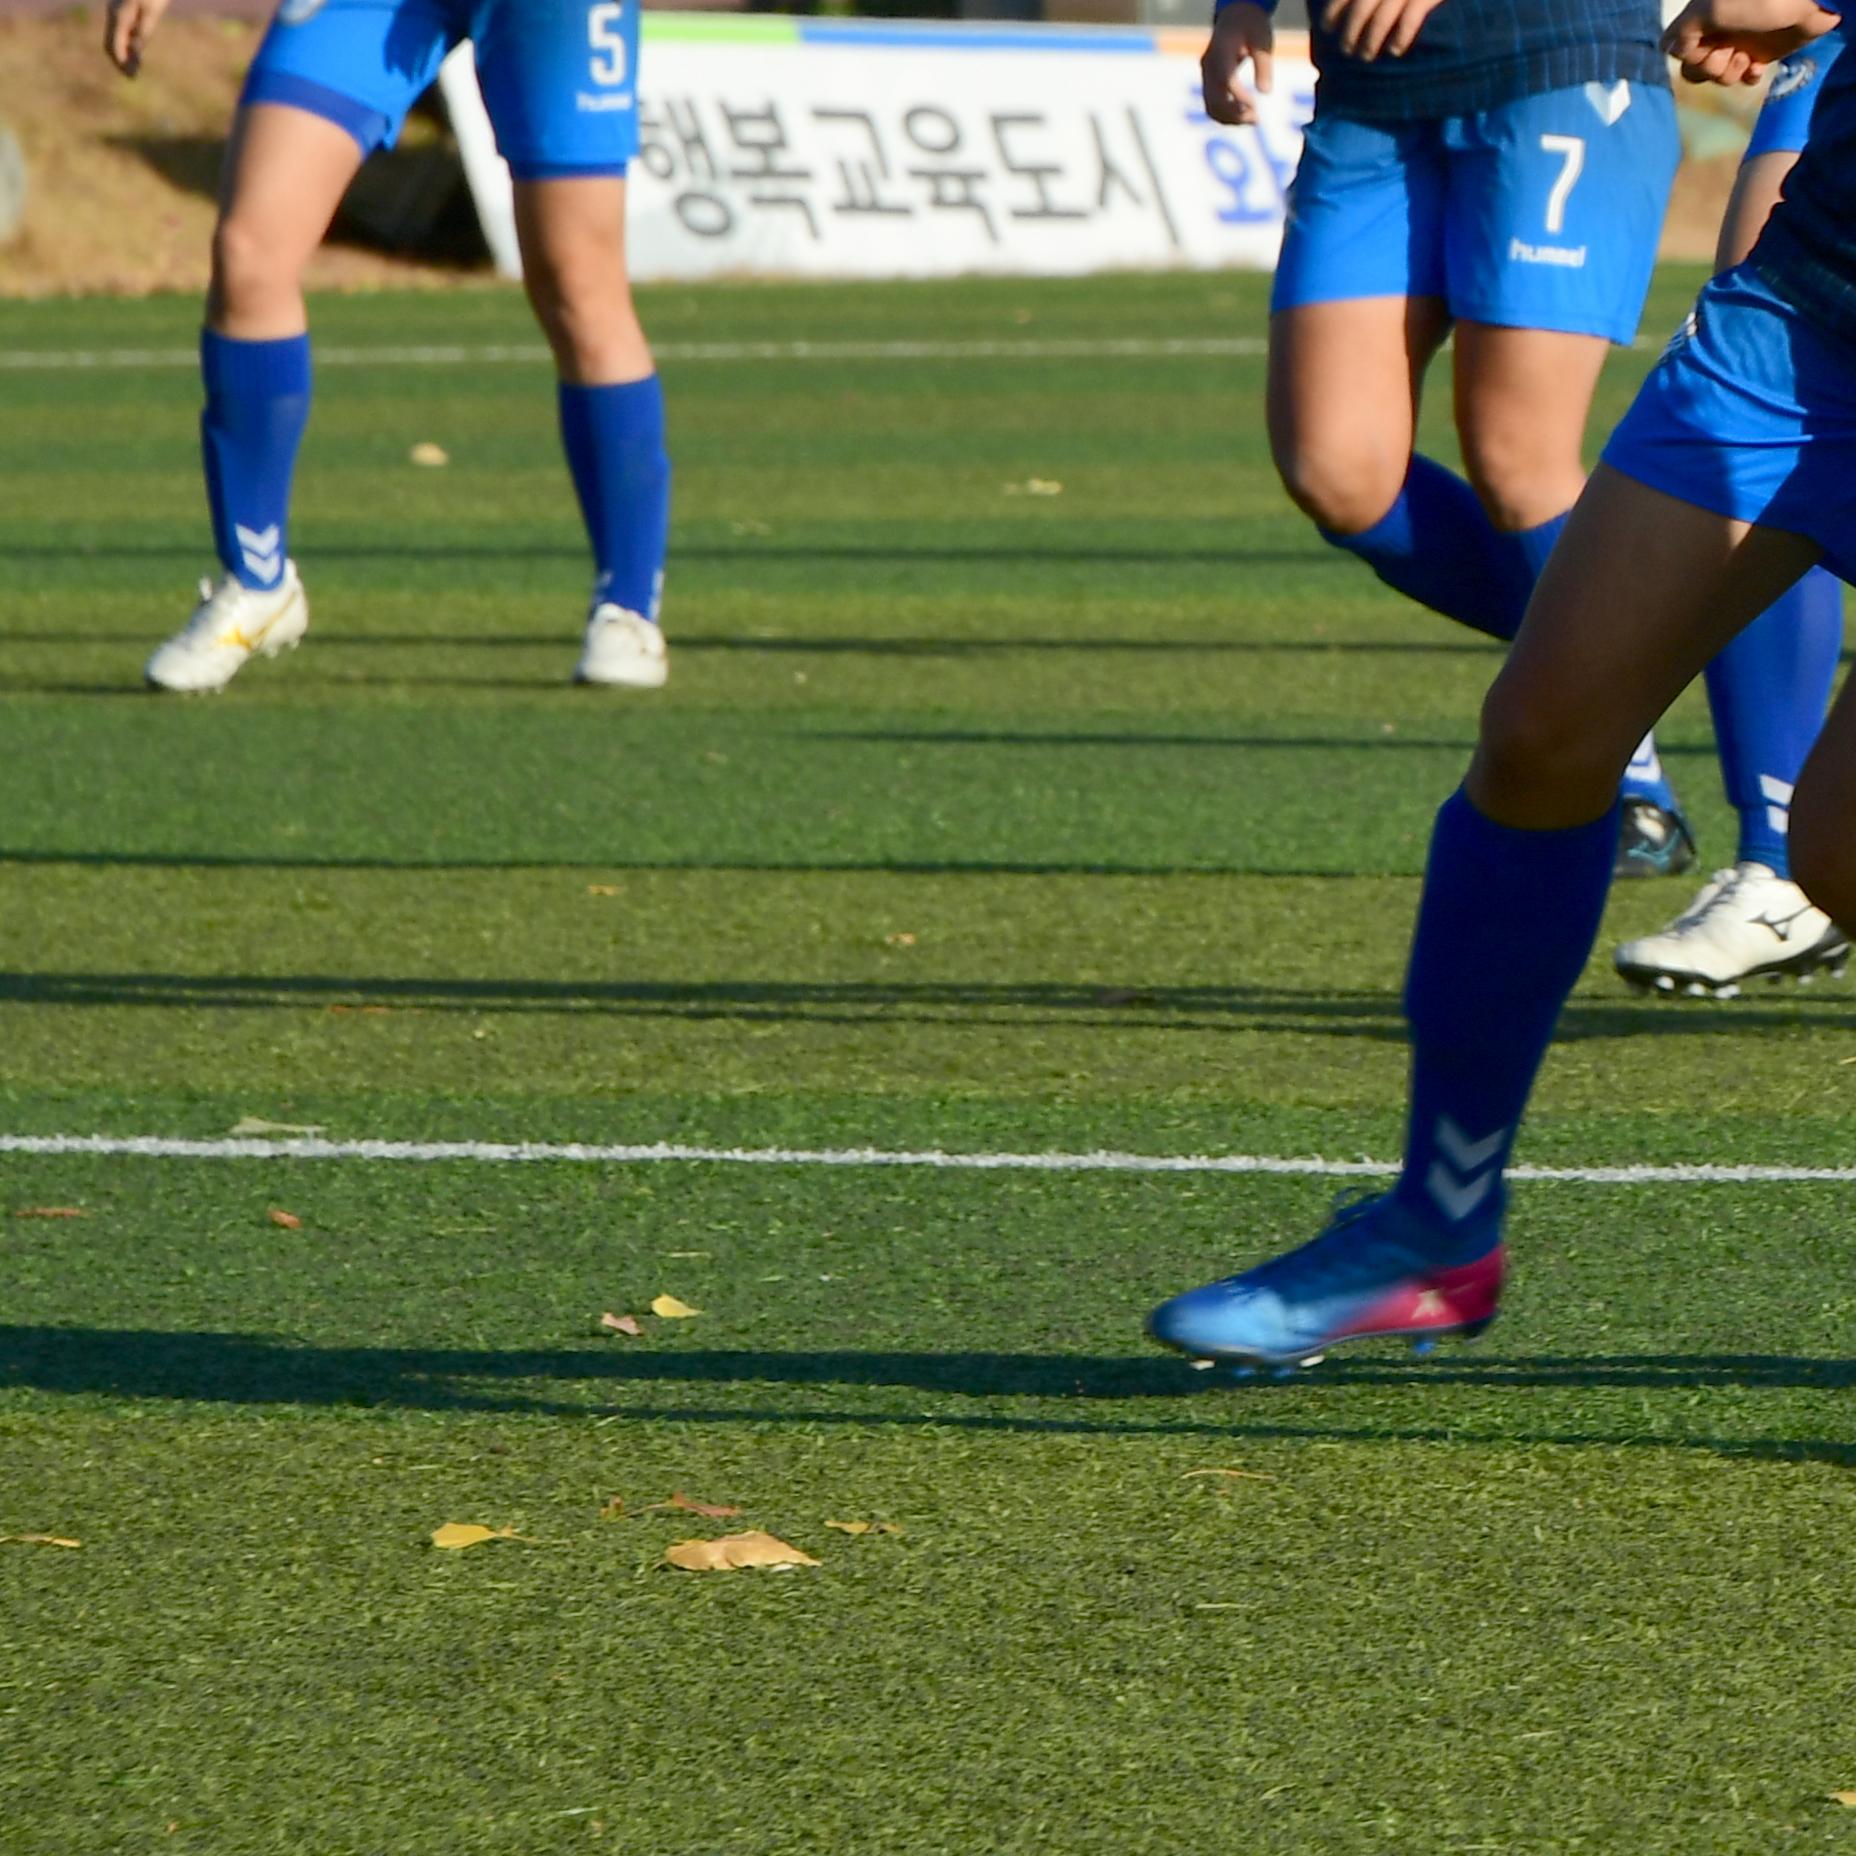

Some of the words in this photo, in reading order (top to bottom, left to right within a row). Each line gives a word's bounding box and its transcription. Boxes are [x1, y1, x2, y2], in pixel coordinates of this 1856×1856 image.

[588, 2, 627, 86] 5
[637, 96, 1182, 245] 행복교육도시
[1540, 132, 1586, 234] 7
[1509, 237, 1587, 269] hummel
